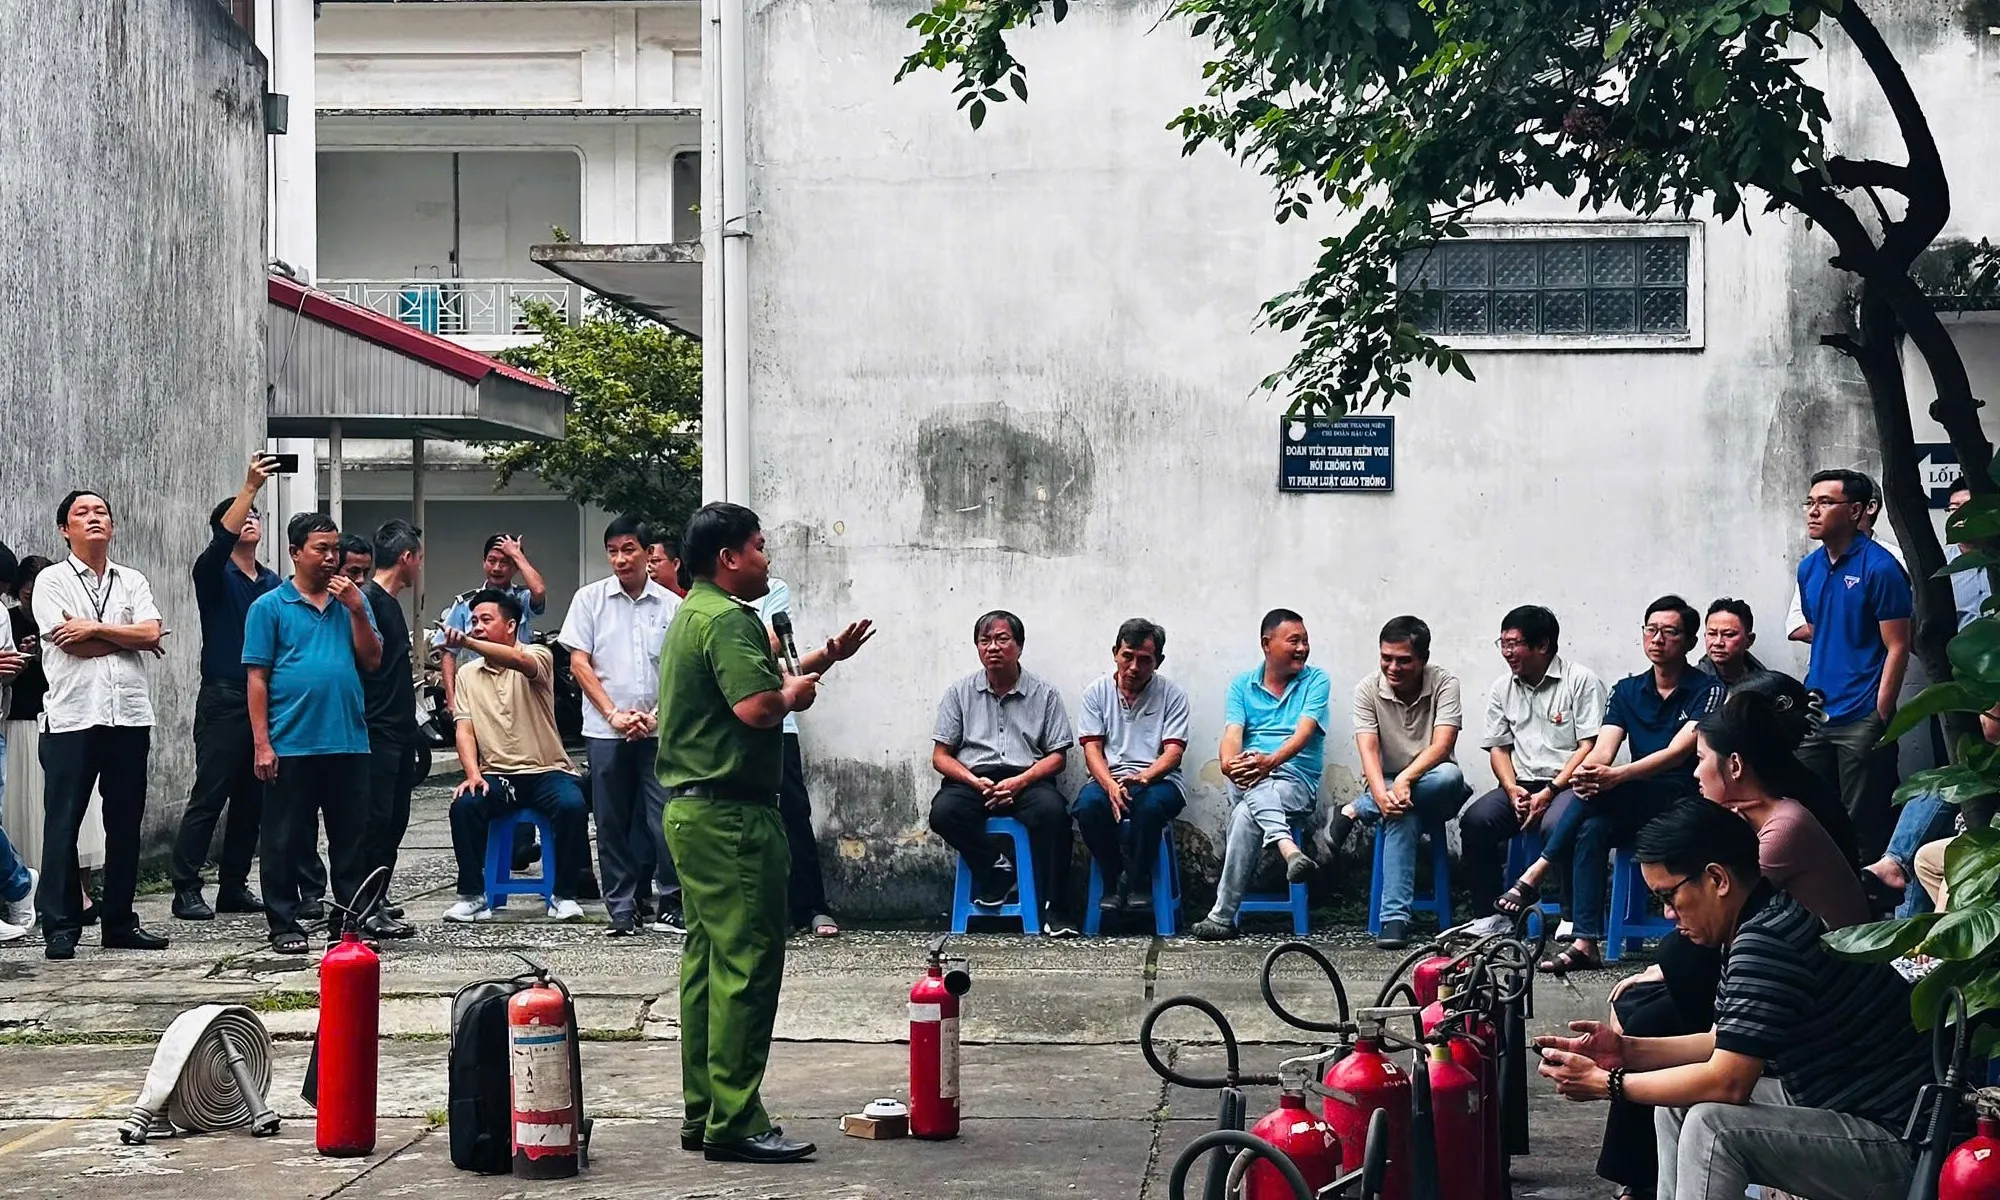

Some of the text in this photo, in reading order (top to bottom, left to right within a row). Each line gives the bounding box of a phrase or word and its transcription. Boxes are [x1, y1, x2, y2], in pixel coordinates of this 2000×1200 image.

[1308, 444, 1326, 456] VIÊN
[1327, 446, 1353, 457] THANH
[1354, 444, 1372, 457] NIÊN
[1373, 446, 1389, 457] VOH
[1310, 459, 1365, 471] NÓI KHÔNG VỚI
[1929, 466, 1953, 482] LỐI
[1288, 474, 1386, 488] VI PHẠM LUẬT GIAO THÔNG
